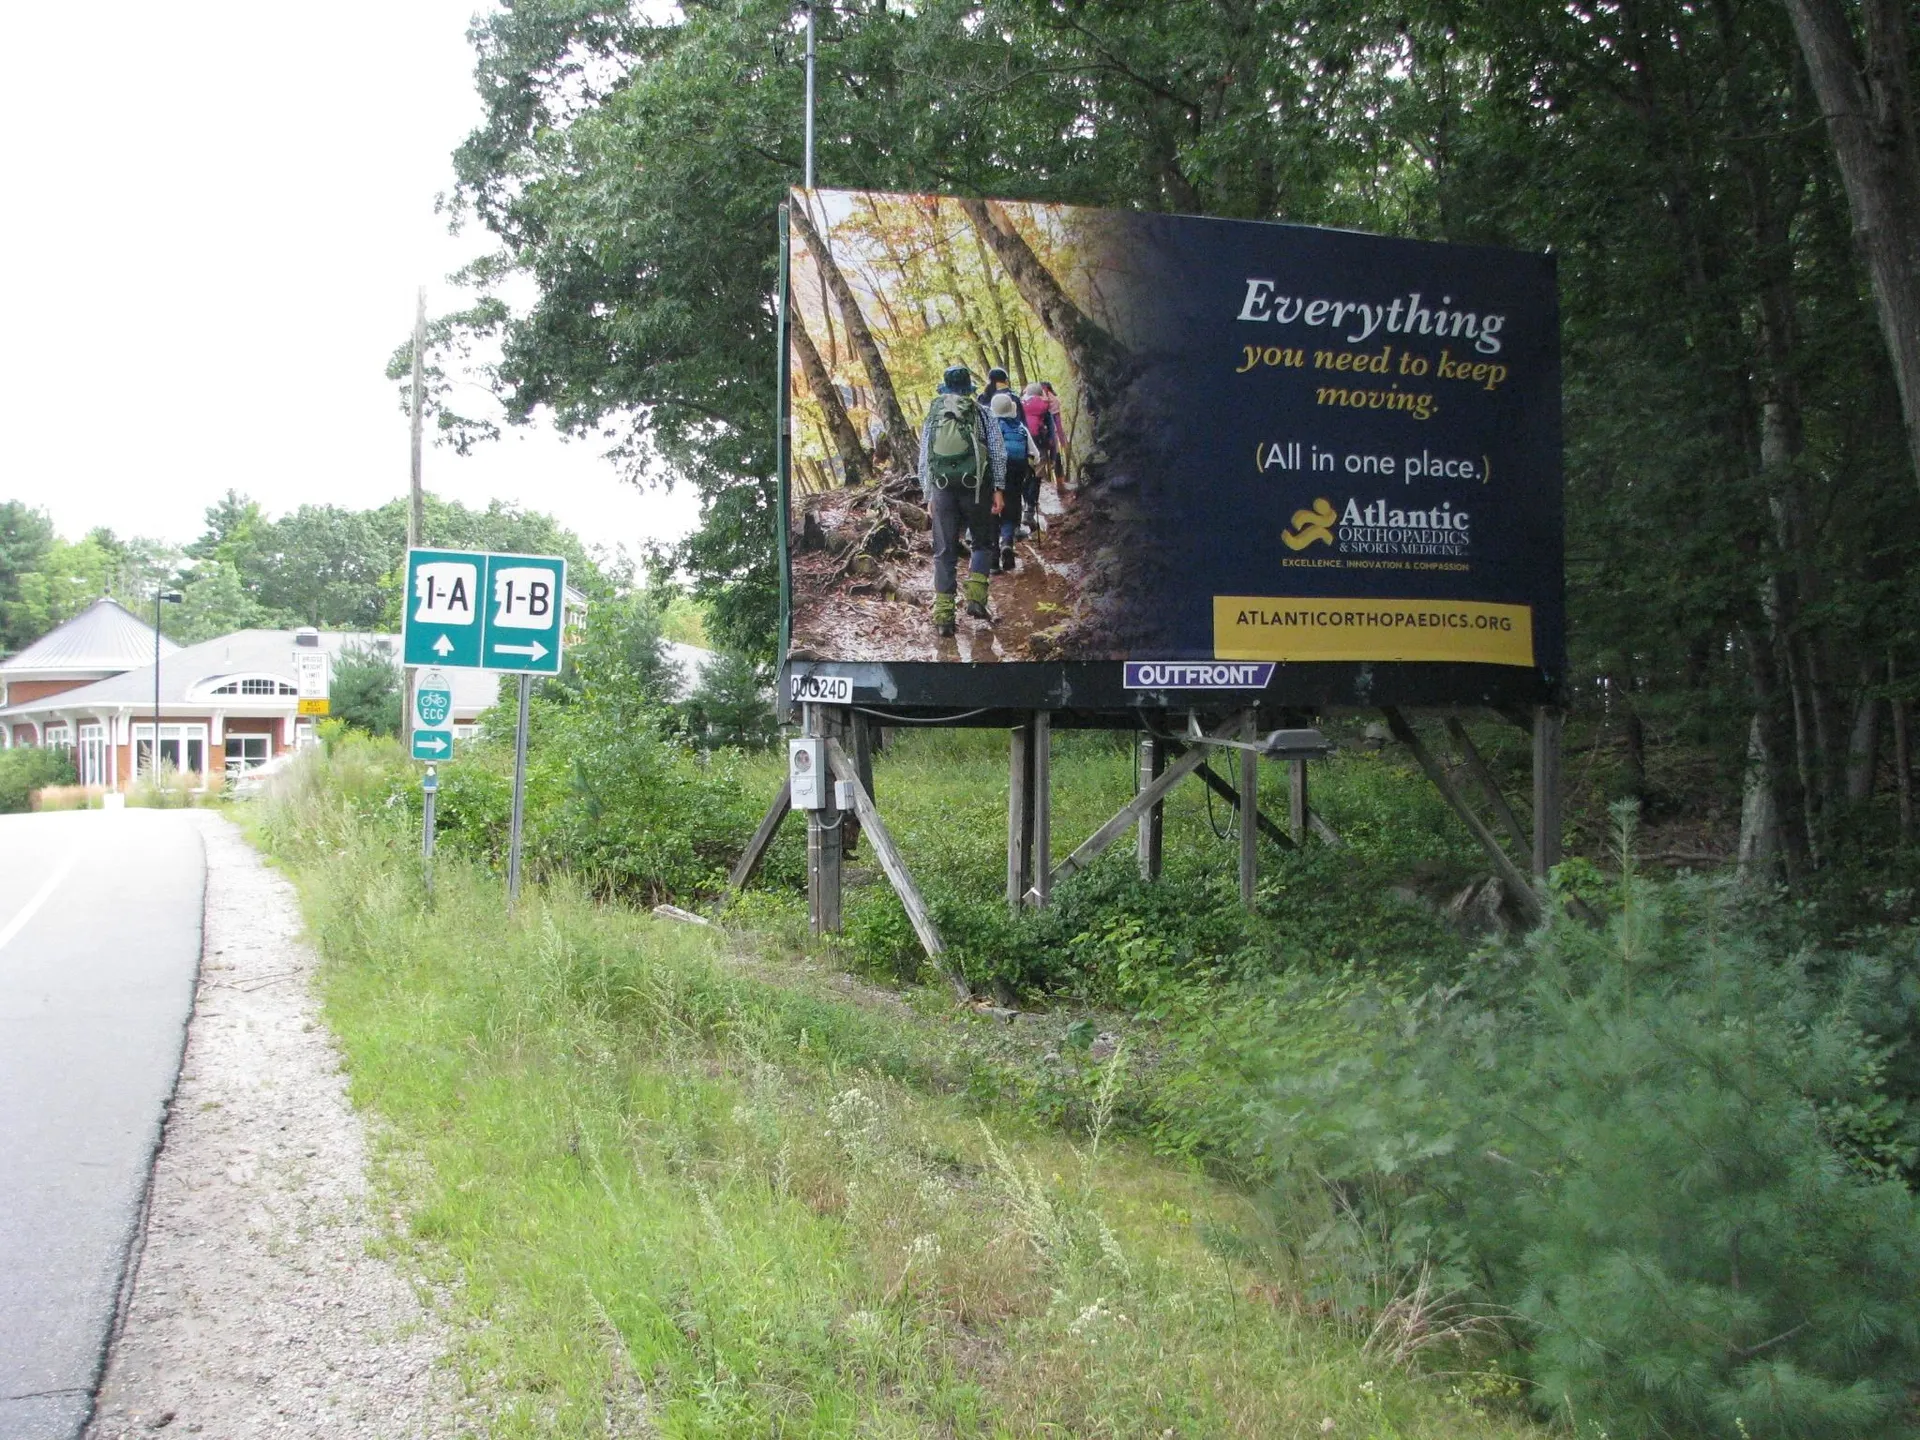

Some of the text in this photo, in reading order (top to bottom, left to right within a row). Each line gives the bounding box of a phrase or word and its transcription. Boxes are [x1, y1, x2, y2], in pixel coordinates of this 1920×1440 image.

[1237, 278, 1505, 354] Everything
[1235, 345, 1507, 391] you need to keep
[1316, 382, 1440, 420] moving.
[1256, 442, 1491, 485] (All in one place.)
[1339, 497, 1470, 531] Atlantic
[1338, 527, 1470, 546] ORTHOPAEDICS
[1339, 543, 1348, 553] &
[1351, 543, 1399, 555] SPORTS
[1401, 545, 1463, 556] MEDICINE
[1346, 560, 1402, 570] INNOVATION
[1404, 561, 1411, 570] &
[1413, 562, 1470, 572] COMPASSION
[426, 575, 469, 612] 1-A
[505, 580, 550, 616] 1-B
[1236, 610, 1512, 631] ATLANTICORTHOPAEDICS.ORG
[1138, 665, 1259, 685] OUTFRONT
[422, 708, 444, 720] ECG
